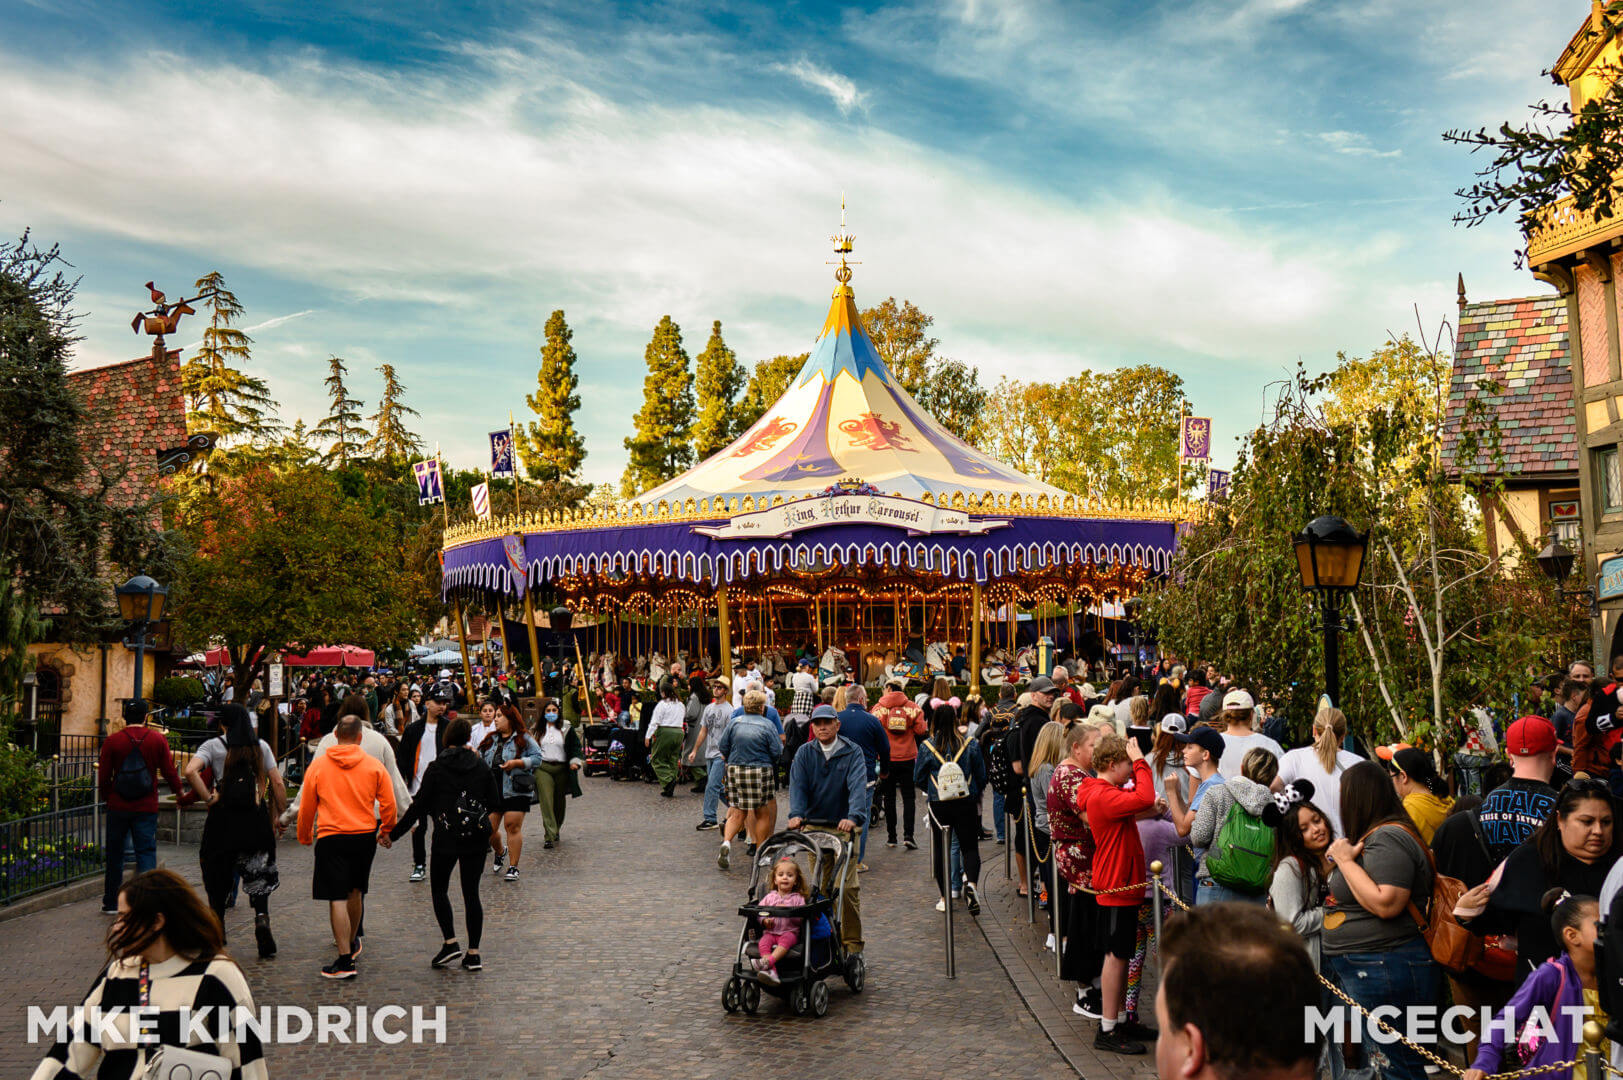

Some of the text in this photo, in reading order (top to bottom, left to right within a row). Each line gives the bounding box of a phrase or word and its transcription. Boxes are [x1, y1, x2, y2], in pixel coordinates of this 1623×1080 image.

[784, 499, 921, 527] King Arthur Carrousel
[1481, 788, 1557, 821] STAR
[1502, 813, 1513, 821] OF
